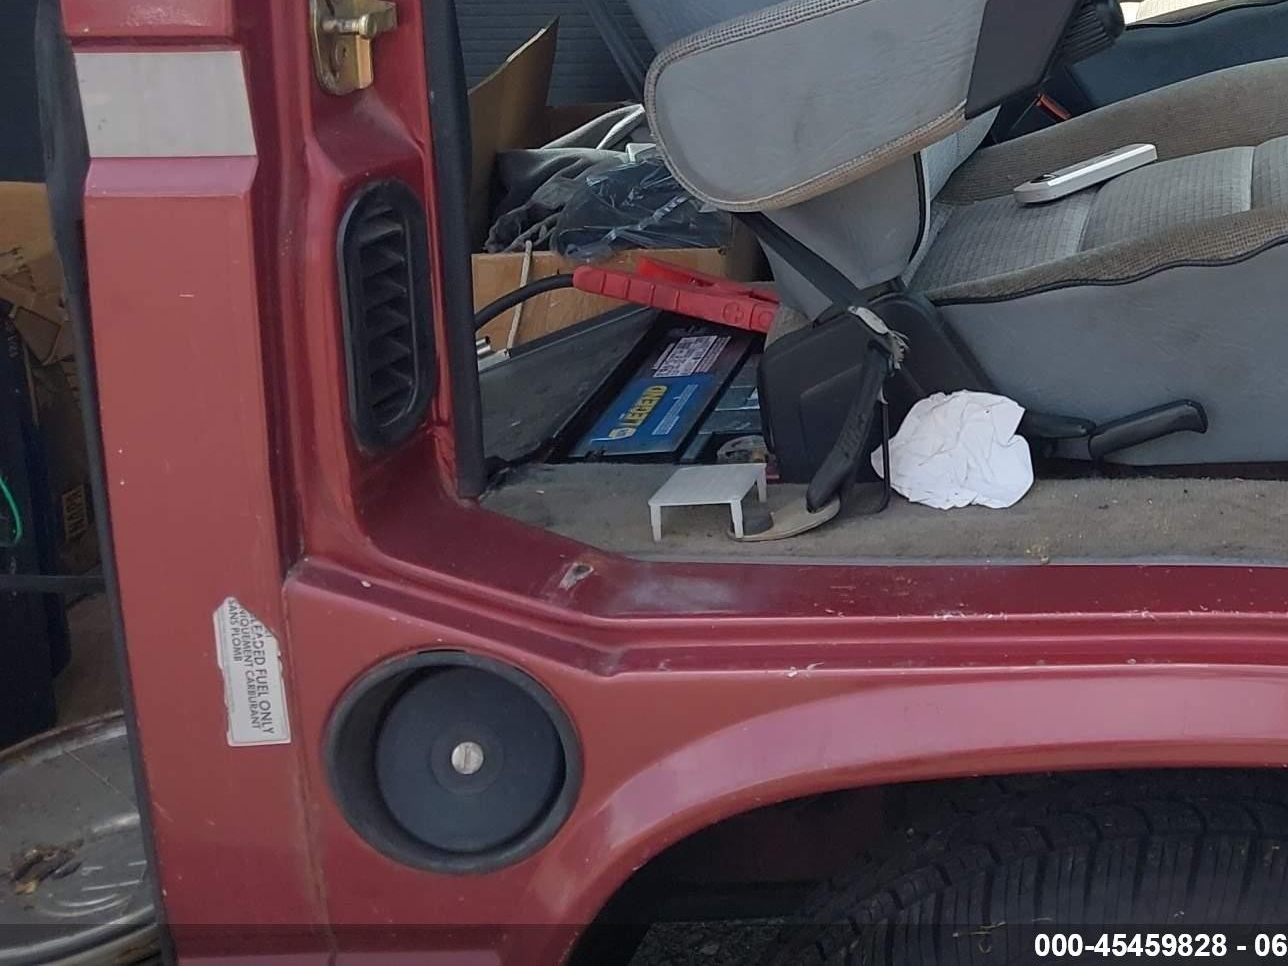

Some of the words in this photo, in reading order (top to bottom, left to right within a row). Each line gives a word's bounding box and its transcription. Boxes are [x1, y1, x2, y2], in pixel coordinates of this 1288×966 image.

[231, 628, 243, 662] PLOMB
[245, 671, 261, 729] CARBURANT
[256, 669, 269, 697] FUEL
[259, 700, 275, 734] ONLY
